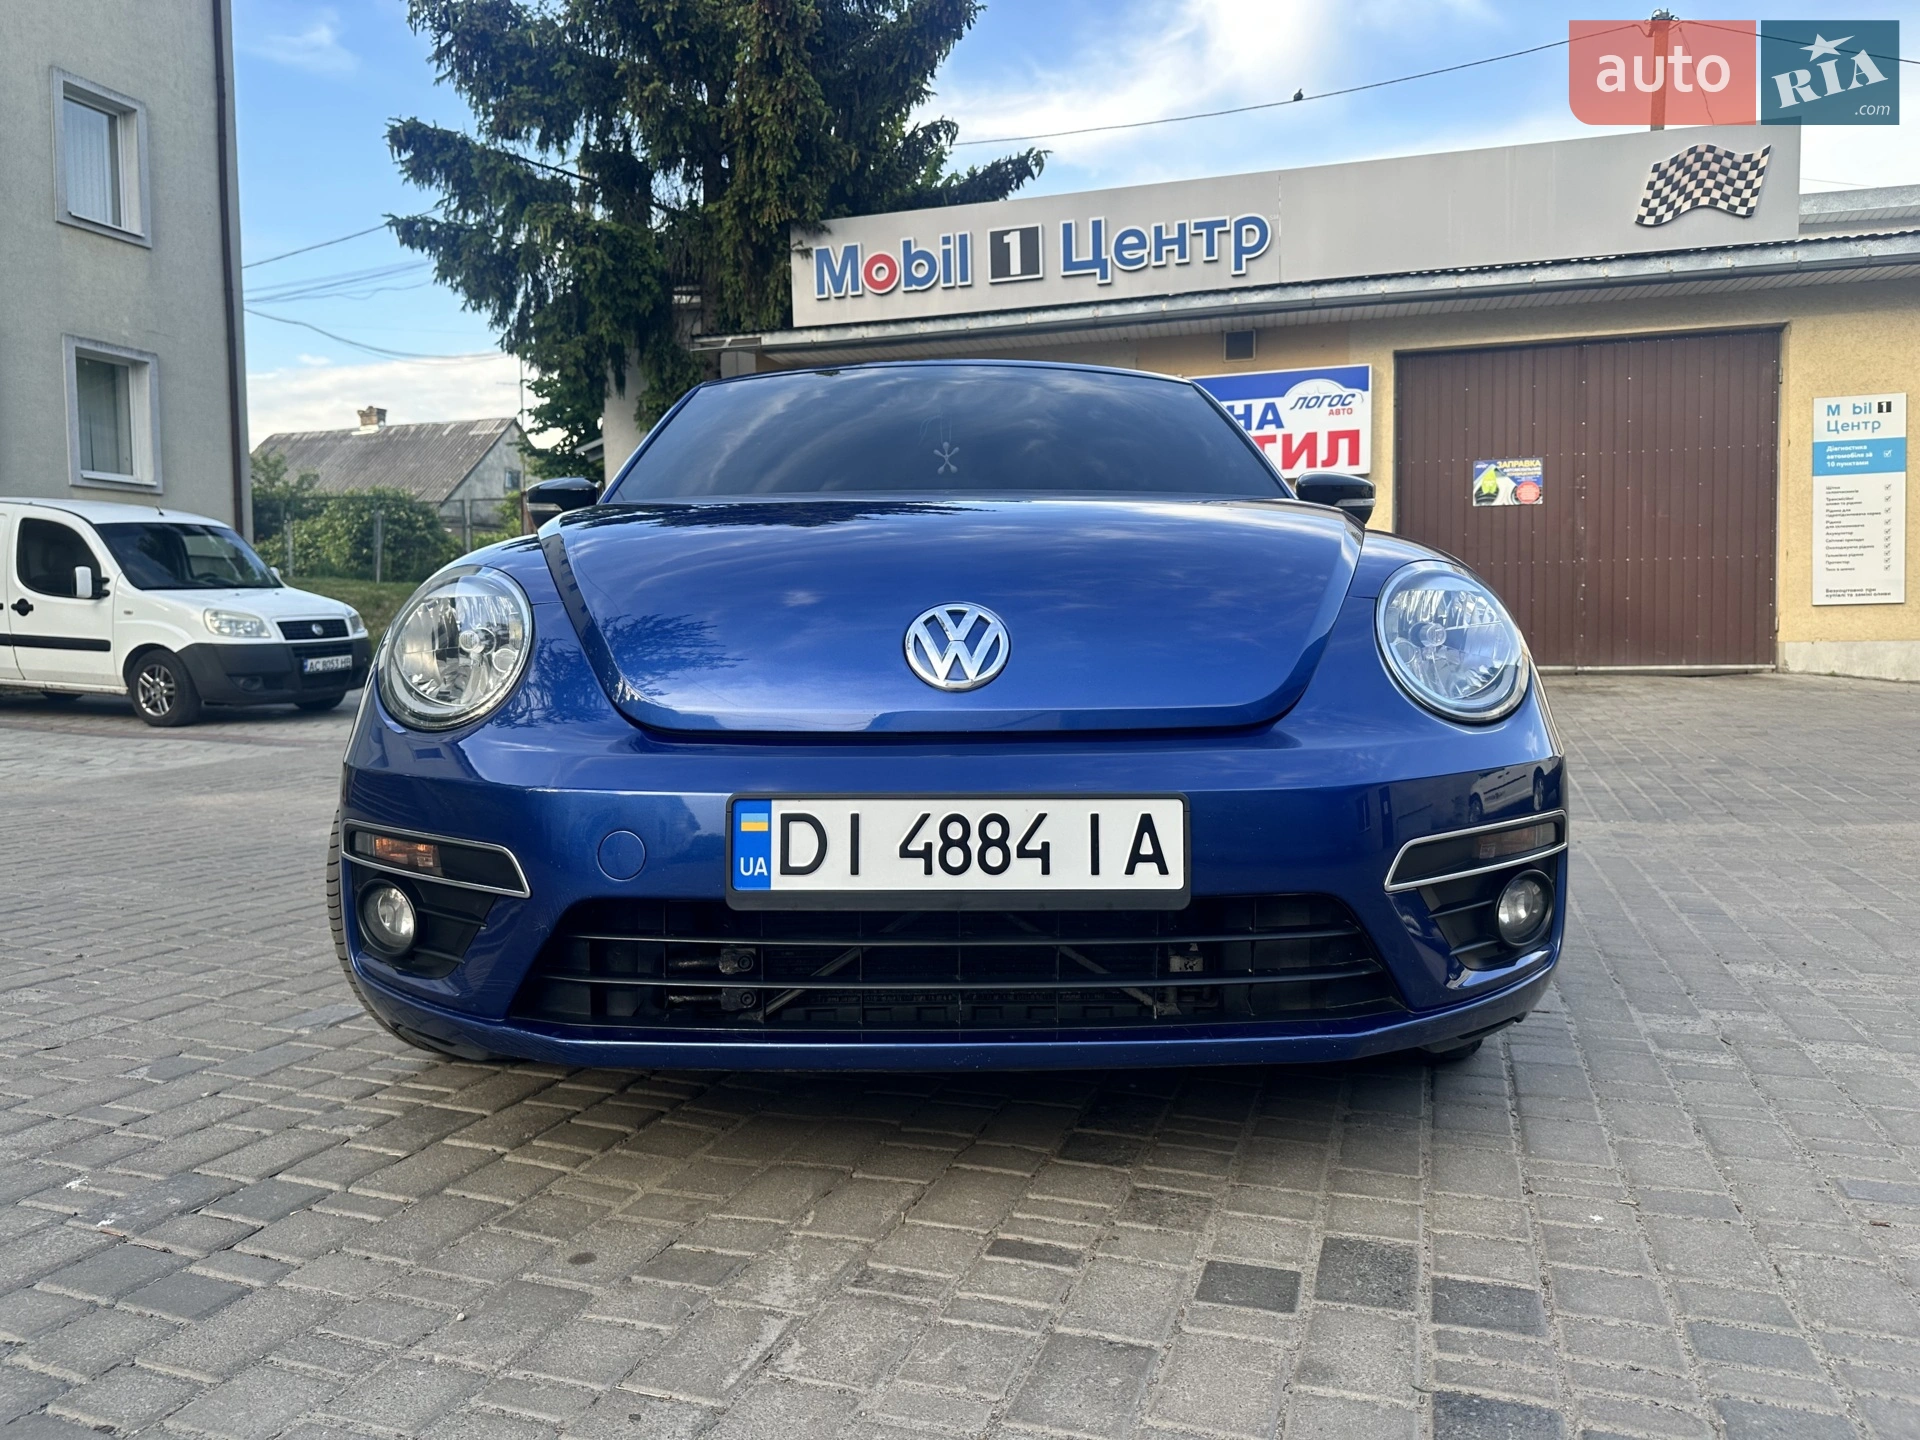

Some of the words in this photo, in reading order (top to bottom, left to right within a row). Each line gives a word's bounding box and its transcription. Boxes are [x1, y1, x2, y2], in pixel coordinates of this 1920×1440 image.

[813, 231, 972, 299] Mobil
[1060, 212, 1272, 285] Центр
[1290, 393, 1355, 410] ЛОГОС
[1226, 402, 1284, 431] НА
[1328, 408, 1353, 416] АВТО
[1827, 420, 1881, 434] Центр
[1497, 460, 1541, 468] ЗАПРАВКА
[309, 661, 320, 672] AC
[779, 812, 860, 876] DI
[898, 812, 1051, 876] 4884
[1089, 812, 1169, 876] IA
[740, 856, 768, 876] UA
